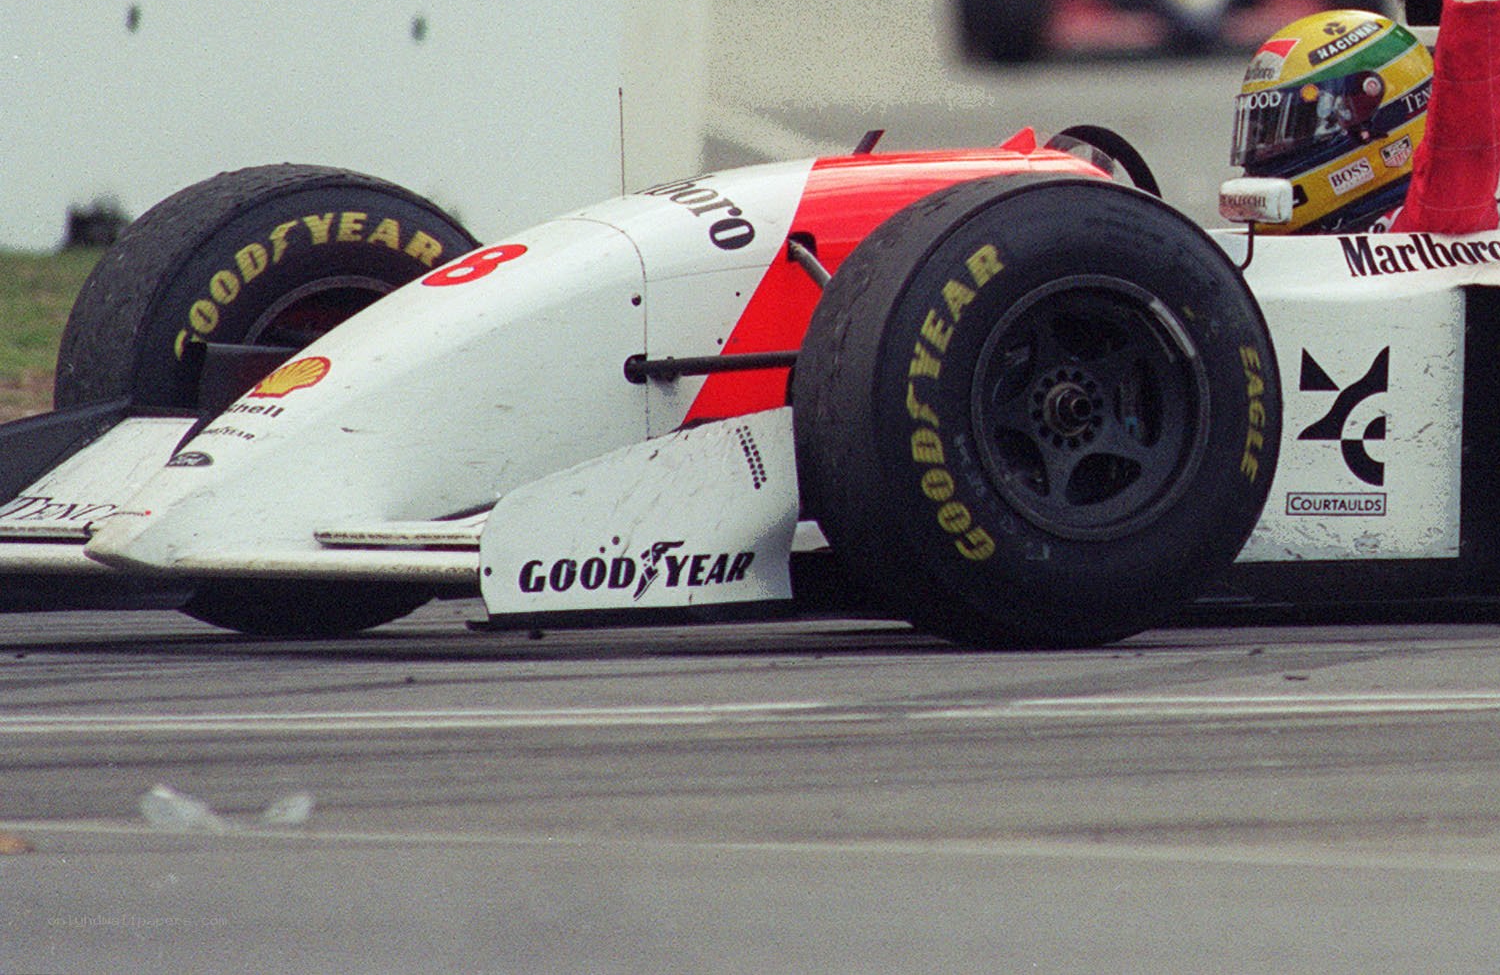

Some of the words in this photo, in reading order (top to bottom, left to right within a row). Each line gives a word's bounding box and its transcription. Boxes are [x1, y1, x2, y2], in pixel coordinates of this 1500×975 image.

[1316, 22, 1380, 60] NACIONAL
[1401, 85, 1433, 114] TEN
[1330, 160, 1371, 188] BOSS
[420, 243, 529, 287] 8
[1238, 344, 1267, 485] EAGLE
[1289, 493, 1383, 512] COURTAULDS
